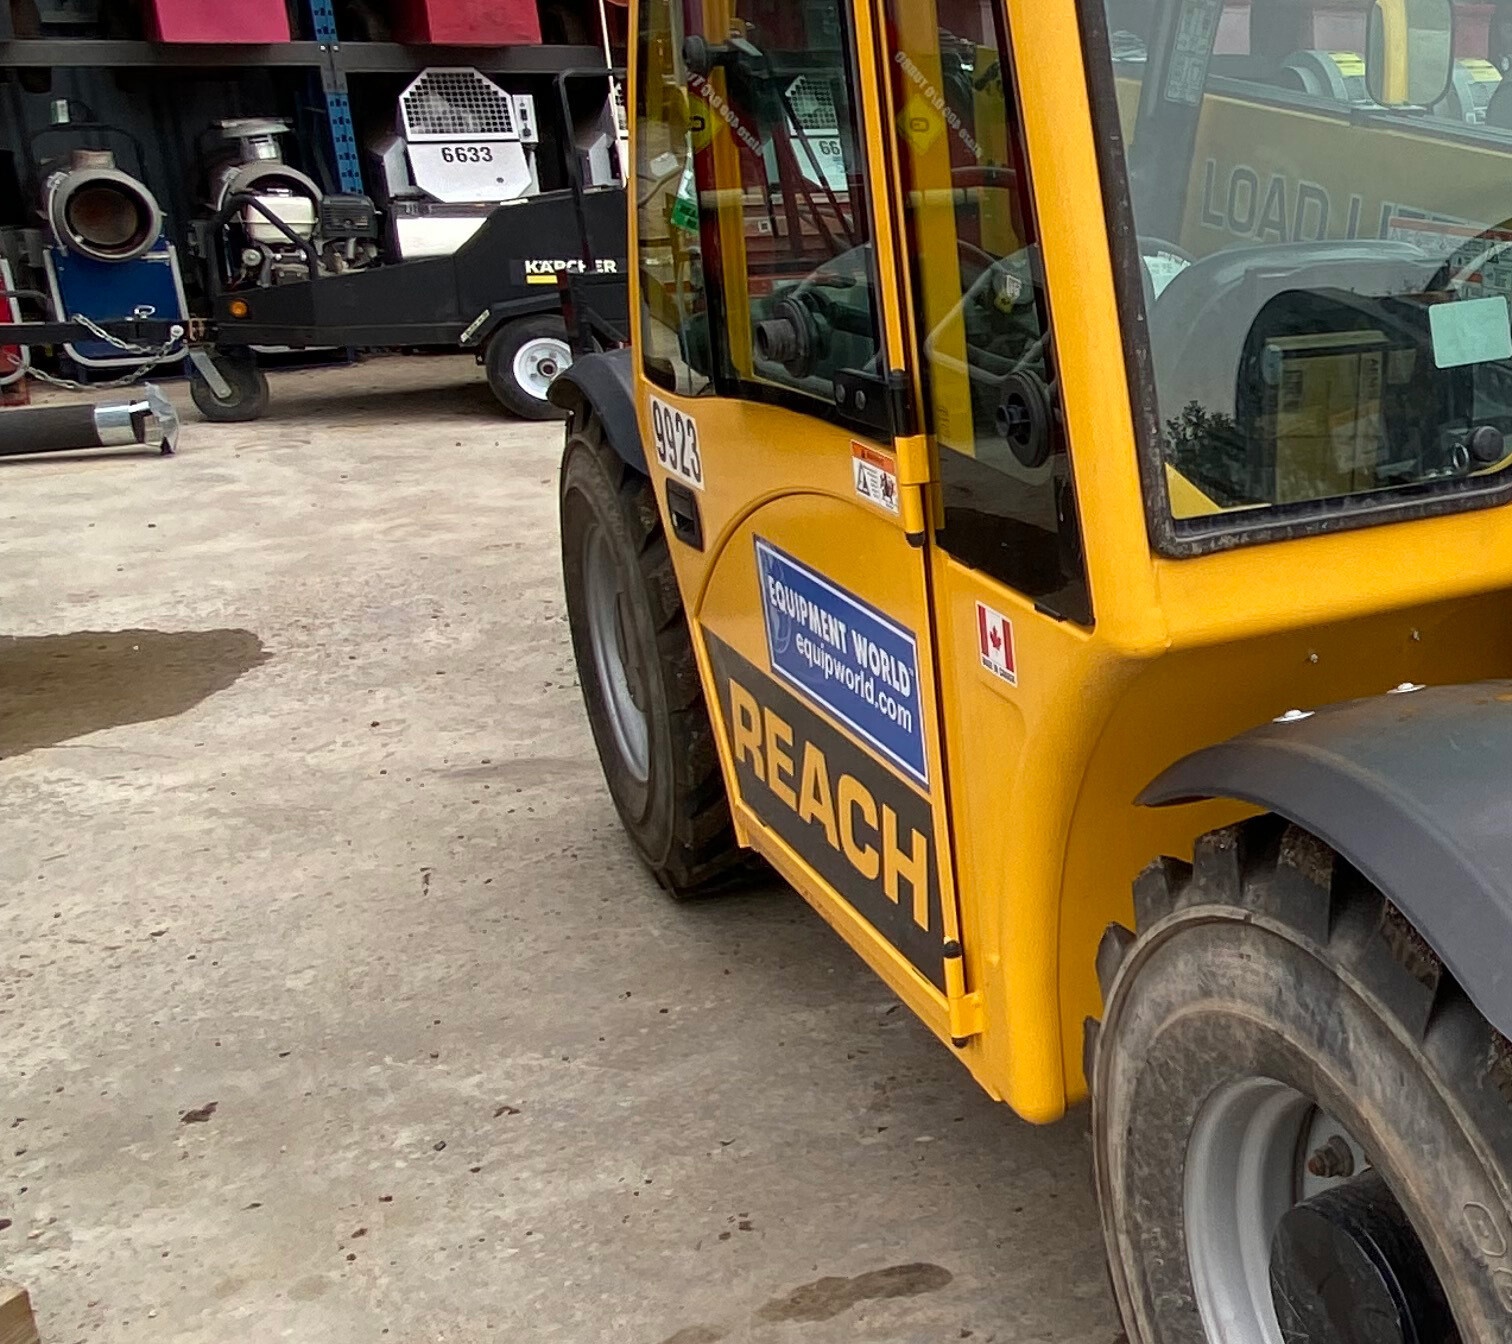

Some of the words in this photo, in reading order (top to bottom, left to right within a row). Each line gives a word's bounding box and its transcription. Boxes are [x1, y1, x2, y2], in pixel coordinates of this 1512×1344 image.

[441, 146, 494, 164] 6633
[653, 400, 702, 484] 9923
[767, 574, 848, 654] EQUIPMENT
[851, 629, 911, 698] WORLD
[796, 632, 913, 733] equipworld.com
[729, 677, 929, 932] REACH
